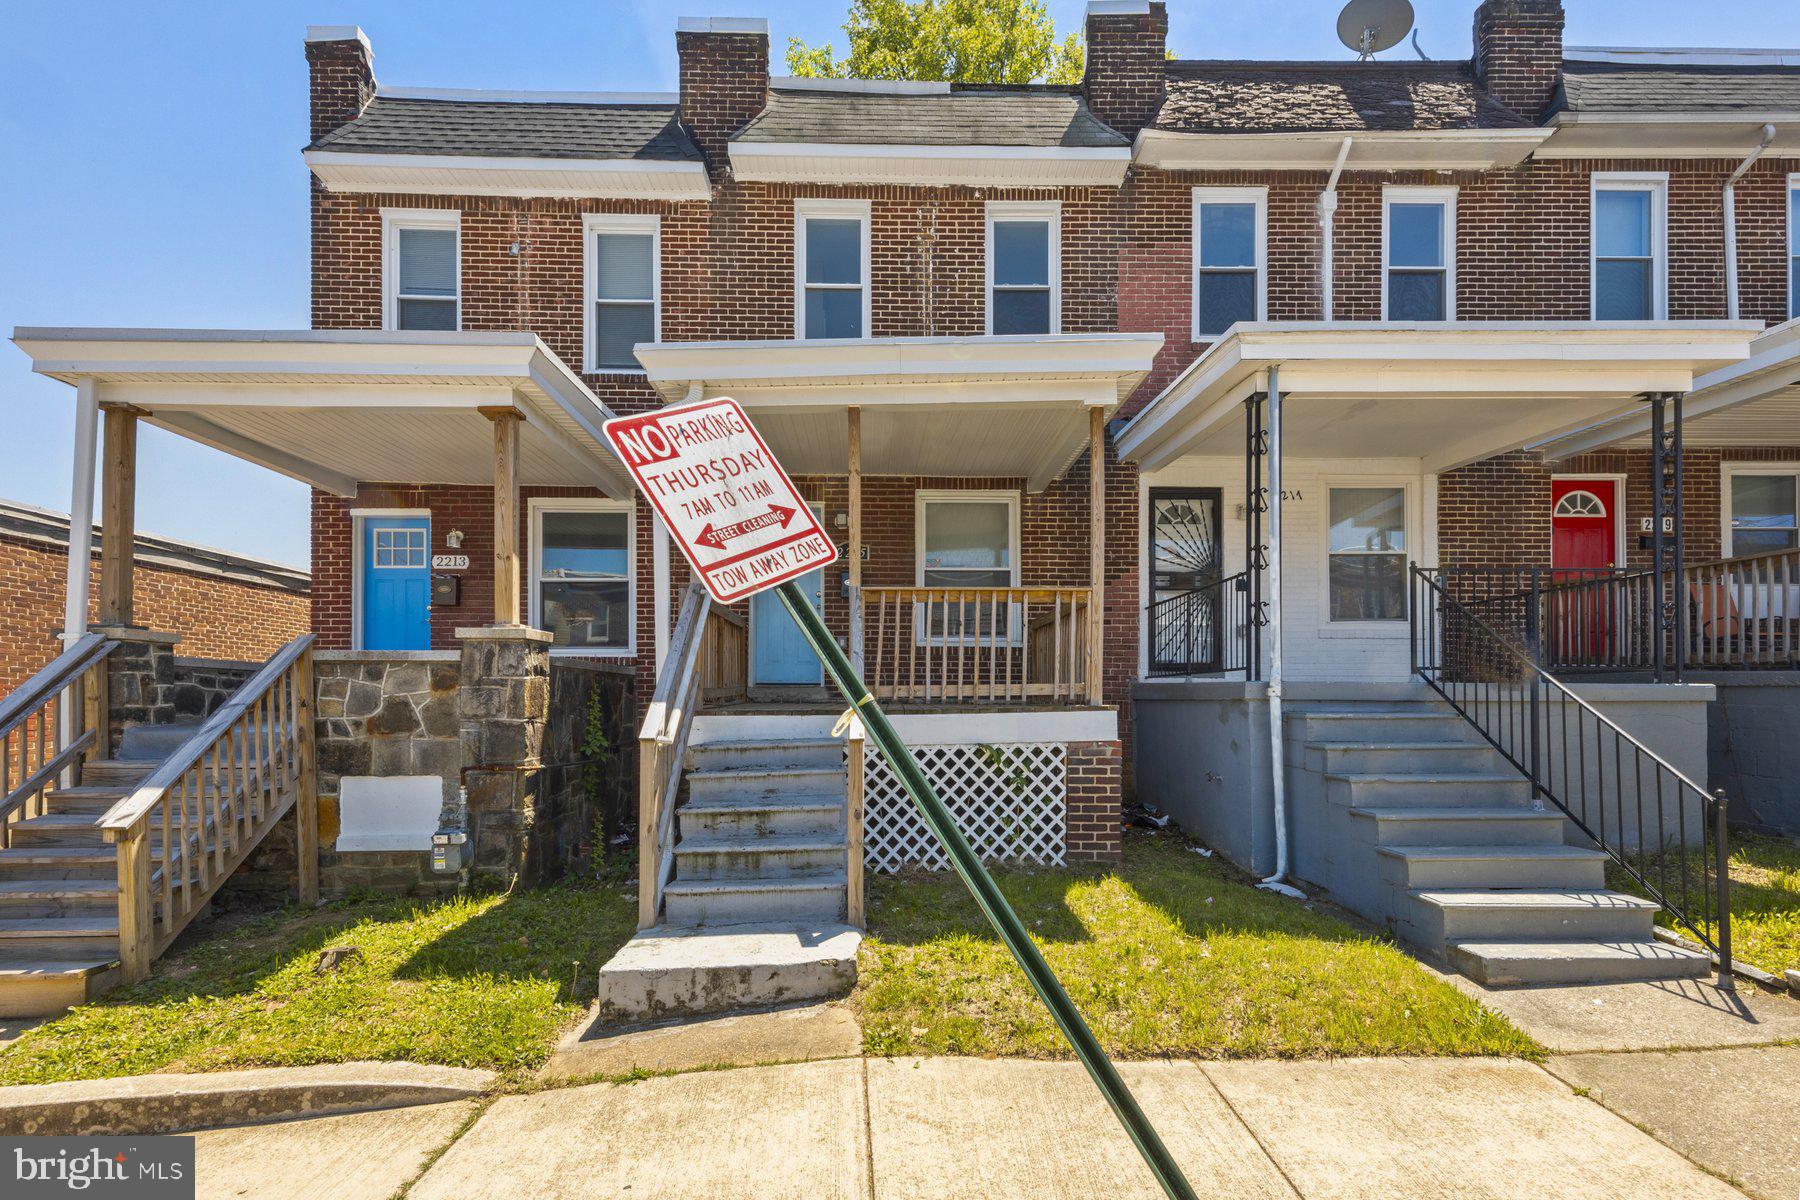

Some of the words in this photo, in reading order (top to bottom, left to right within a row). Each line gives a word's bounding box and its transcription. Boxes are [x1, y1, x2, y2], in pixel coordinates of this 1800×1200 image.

[617, 424, 673, 464] NO
[665, 411, 745, 448] PARKING
[647, 448, 766, 497] THURSDAY
[714, 490, 737, 510] TO
[707, 526, 741, 544] STREET
[742, 510, 785, 532] CLEANING
[436, 556, 466, 567] 2213
[712, 565, 748, 591] TOW
[749, 550, 789, 579] AWAY
[788, 537, 827, 563] ZONE
